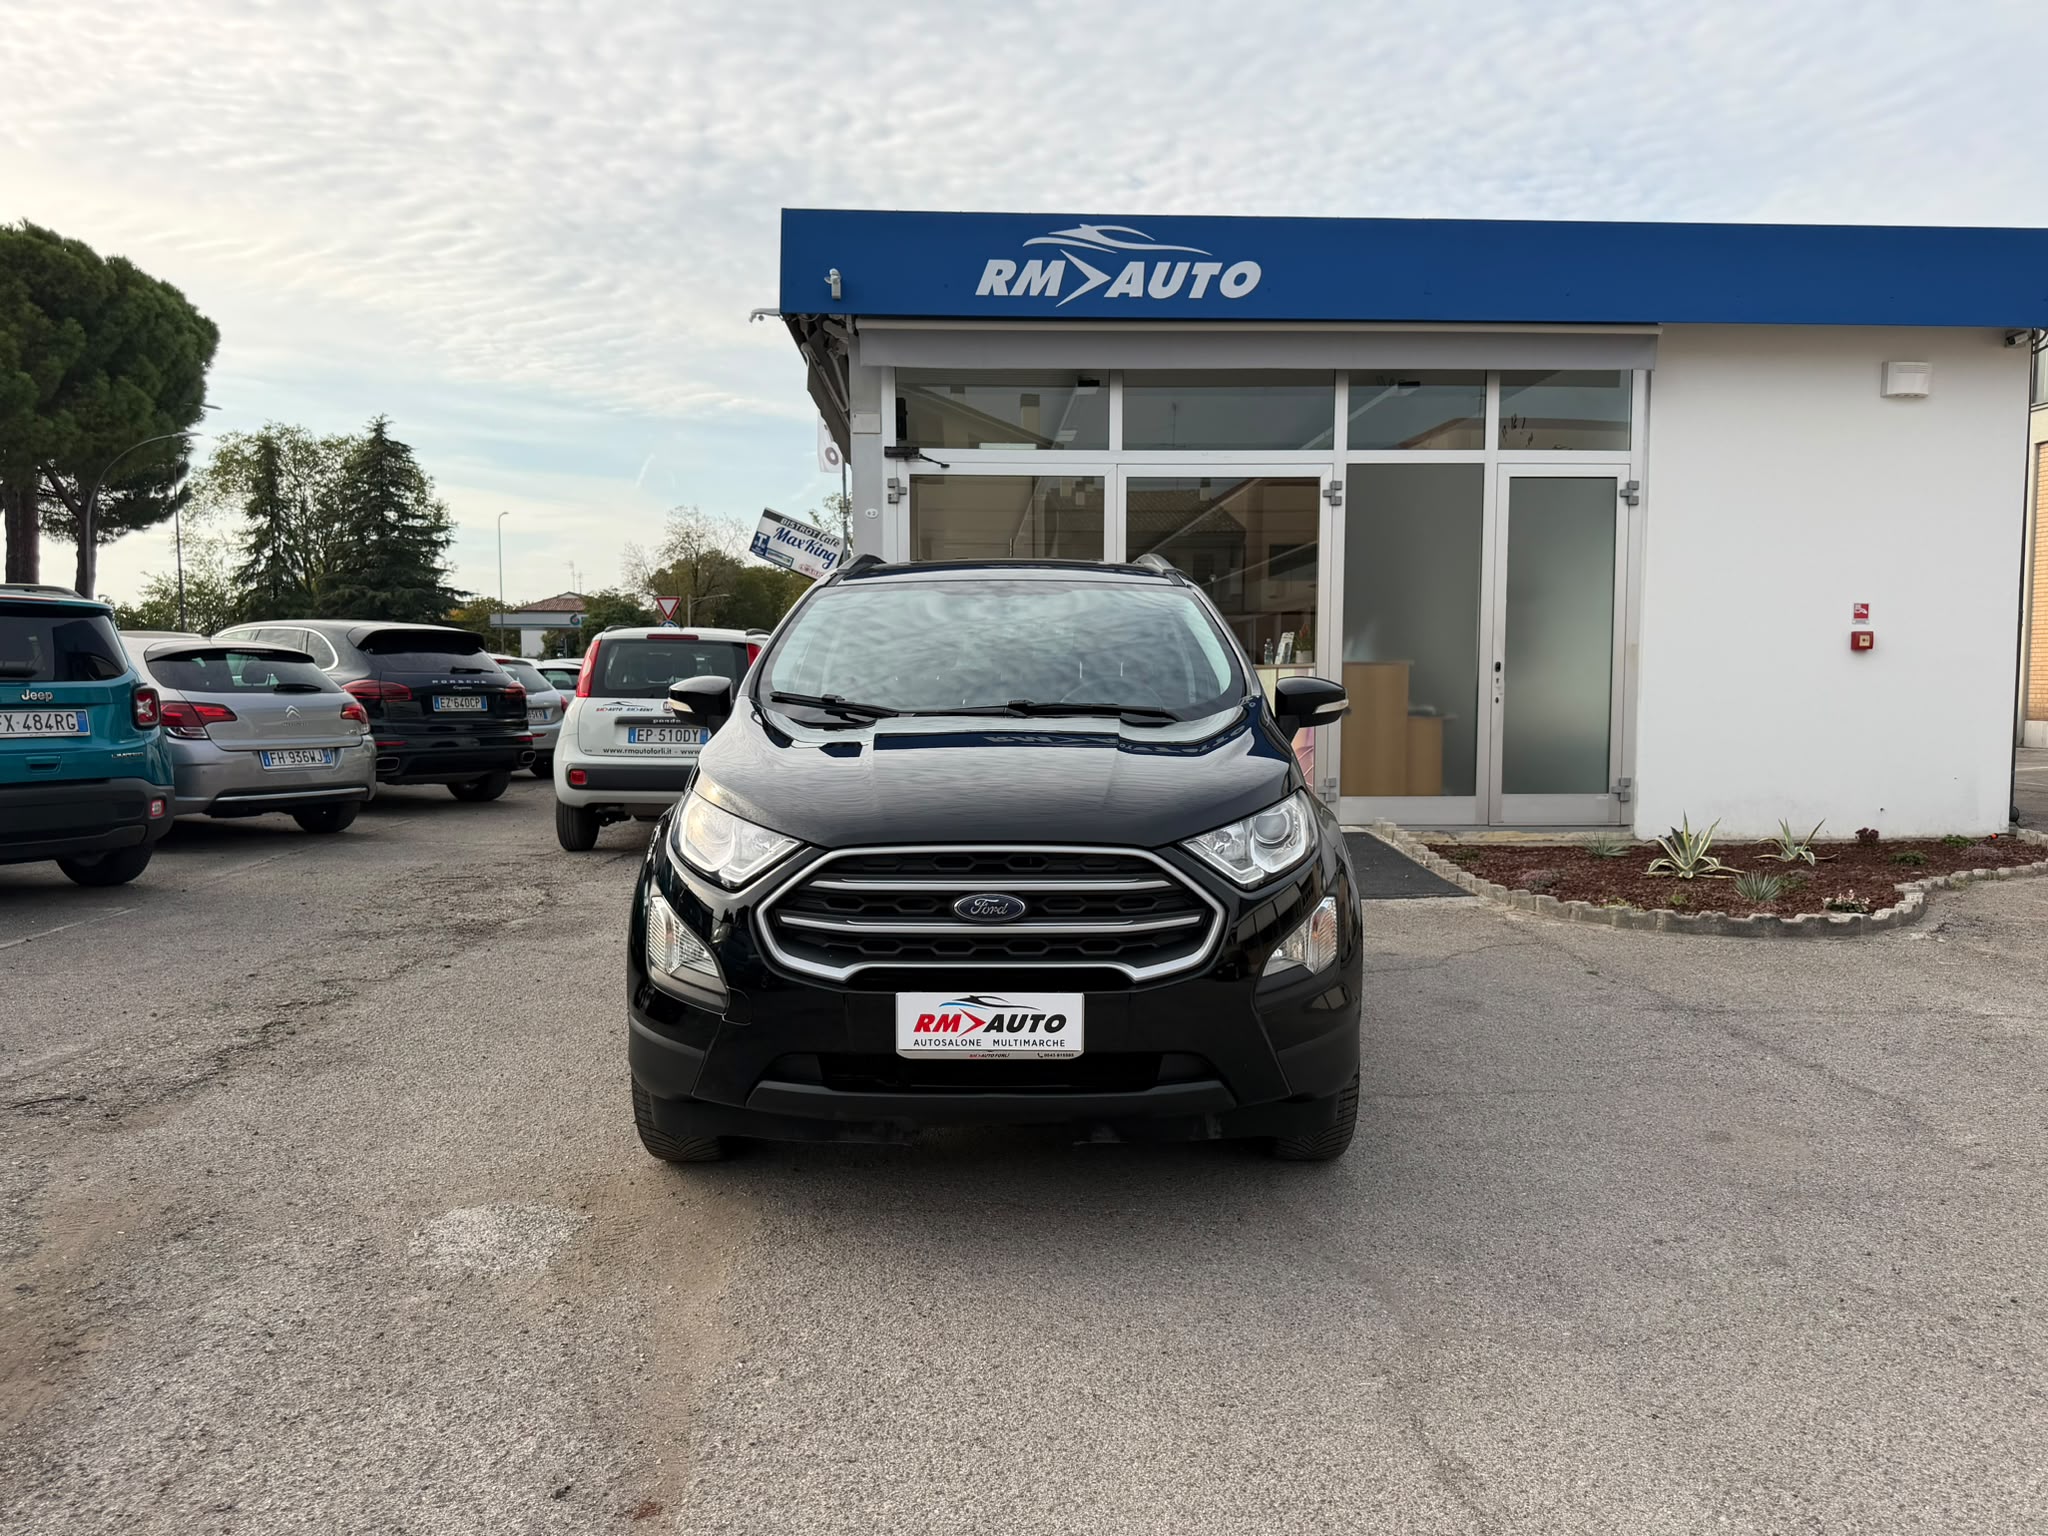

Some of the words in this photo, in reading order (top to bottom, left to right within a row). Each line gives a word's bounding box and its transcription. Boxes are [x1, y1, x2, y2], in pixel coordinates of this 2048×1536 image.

[975, 259, 1066, 297] RM
[1103, 260, 1262, 299] AUTO
[780, 517, 820, 539] BISTROT
[21, 689, 54, 702] Jeep
[637, 729, 653, 742] EP
[603, 747, 672, 755] www.rmautoforli.it
[970, 898, 1009, 914] Ford
[913, 1014, 962, 1033] RM
[982, 1014, 1067, 1033] AUTO
[913, 1038, 982, 1047] AUTOSALONE
[993, 1039, 1065, 1047] MULTIMARCHE
